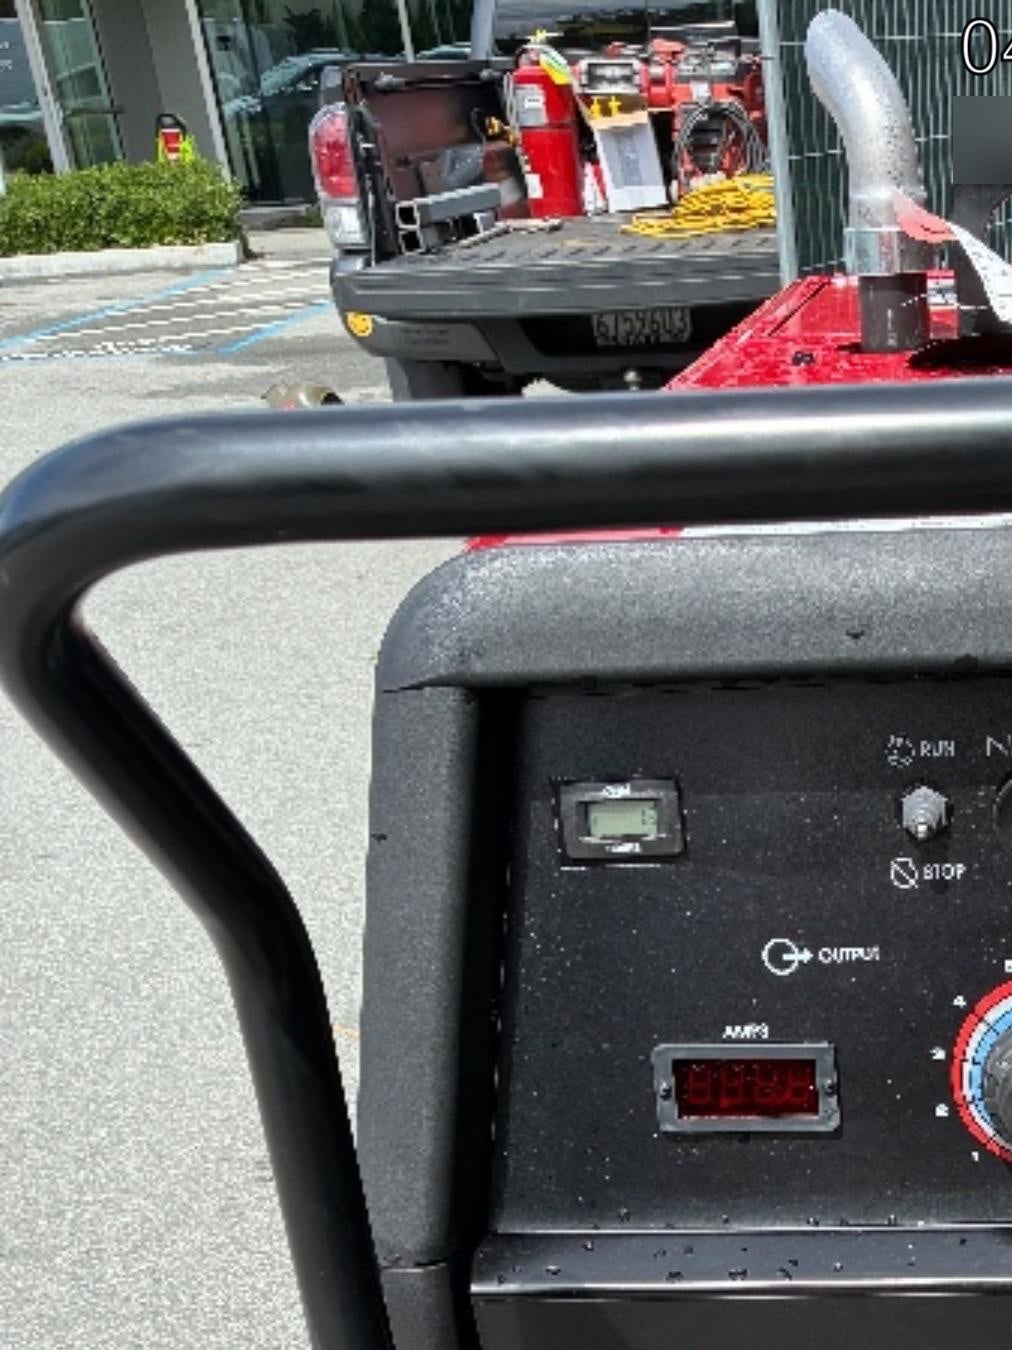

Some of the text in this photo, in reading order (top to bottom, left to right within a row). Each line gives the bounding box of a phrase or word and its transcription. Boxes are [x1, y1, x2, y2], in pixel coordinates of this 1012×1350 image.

[920, 740, 956, 758] RUN
[922, 862, 967, 881] STOP
[817, 944, 881, 964] OUTPUT
[953, 995, 967, 1007] 4
